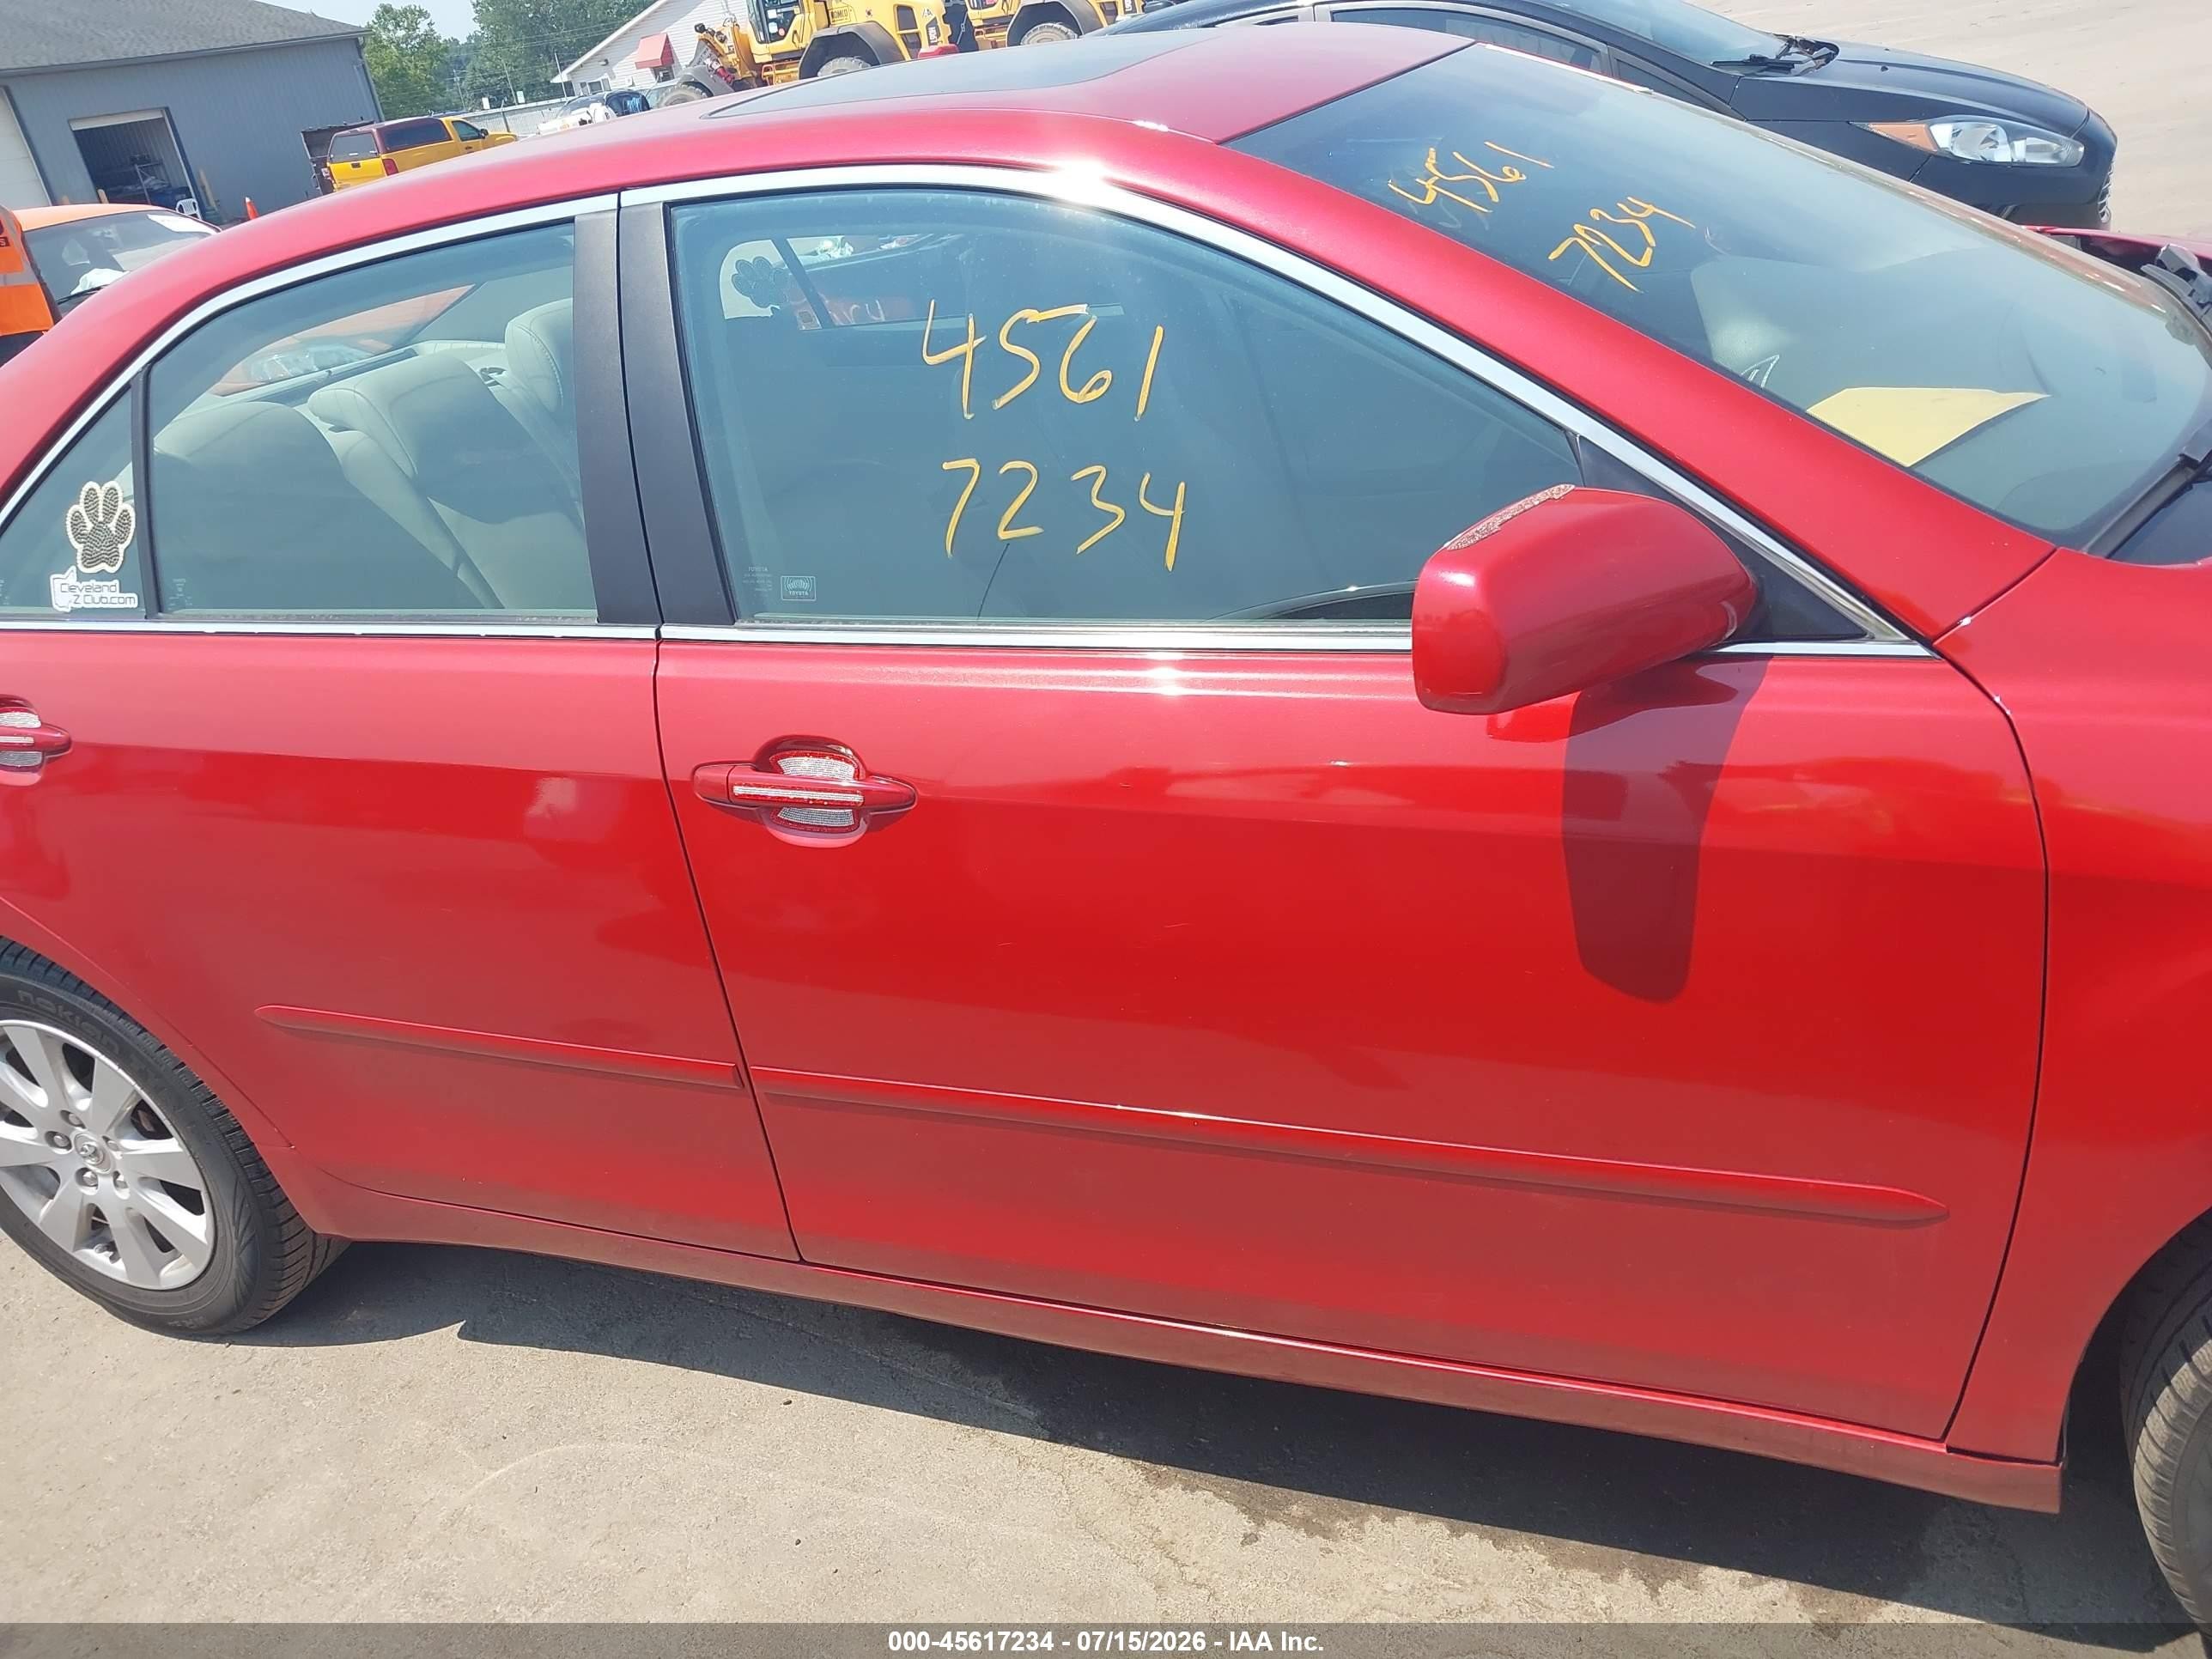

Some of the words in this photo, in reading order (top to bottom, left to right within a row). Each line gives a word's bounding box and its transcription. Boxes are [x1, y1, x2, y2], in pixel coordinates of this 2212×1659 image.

[1387, 140, 1555, 214] 4561
[1547, 196, 1697, 294] 7234
[922, 299, 1164, 422] 4561
[942, 458, 1186, 572] 7234
[60, 581, 118, 593] Cleveland
